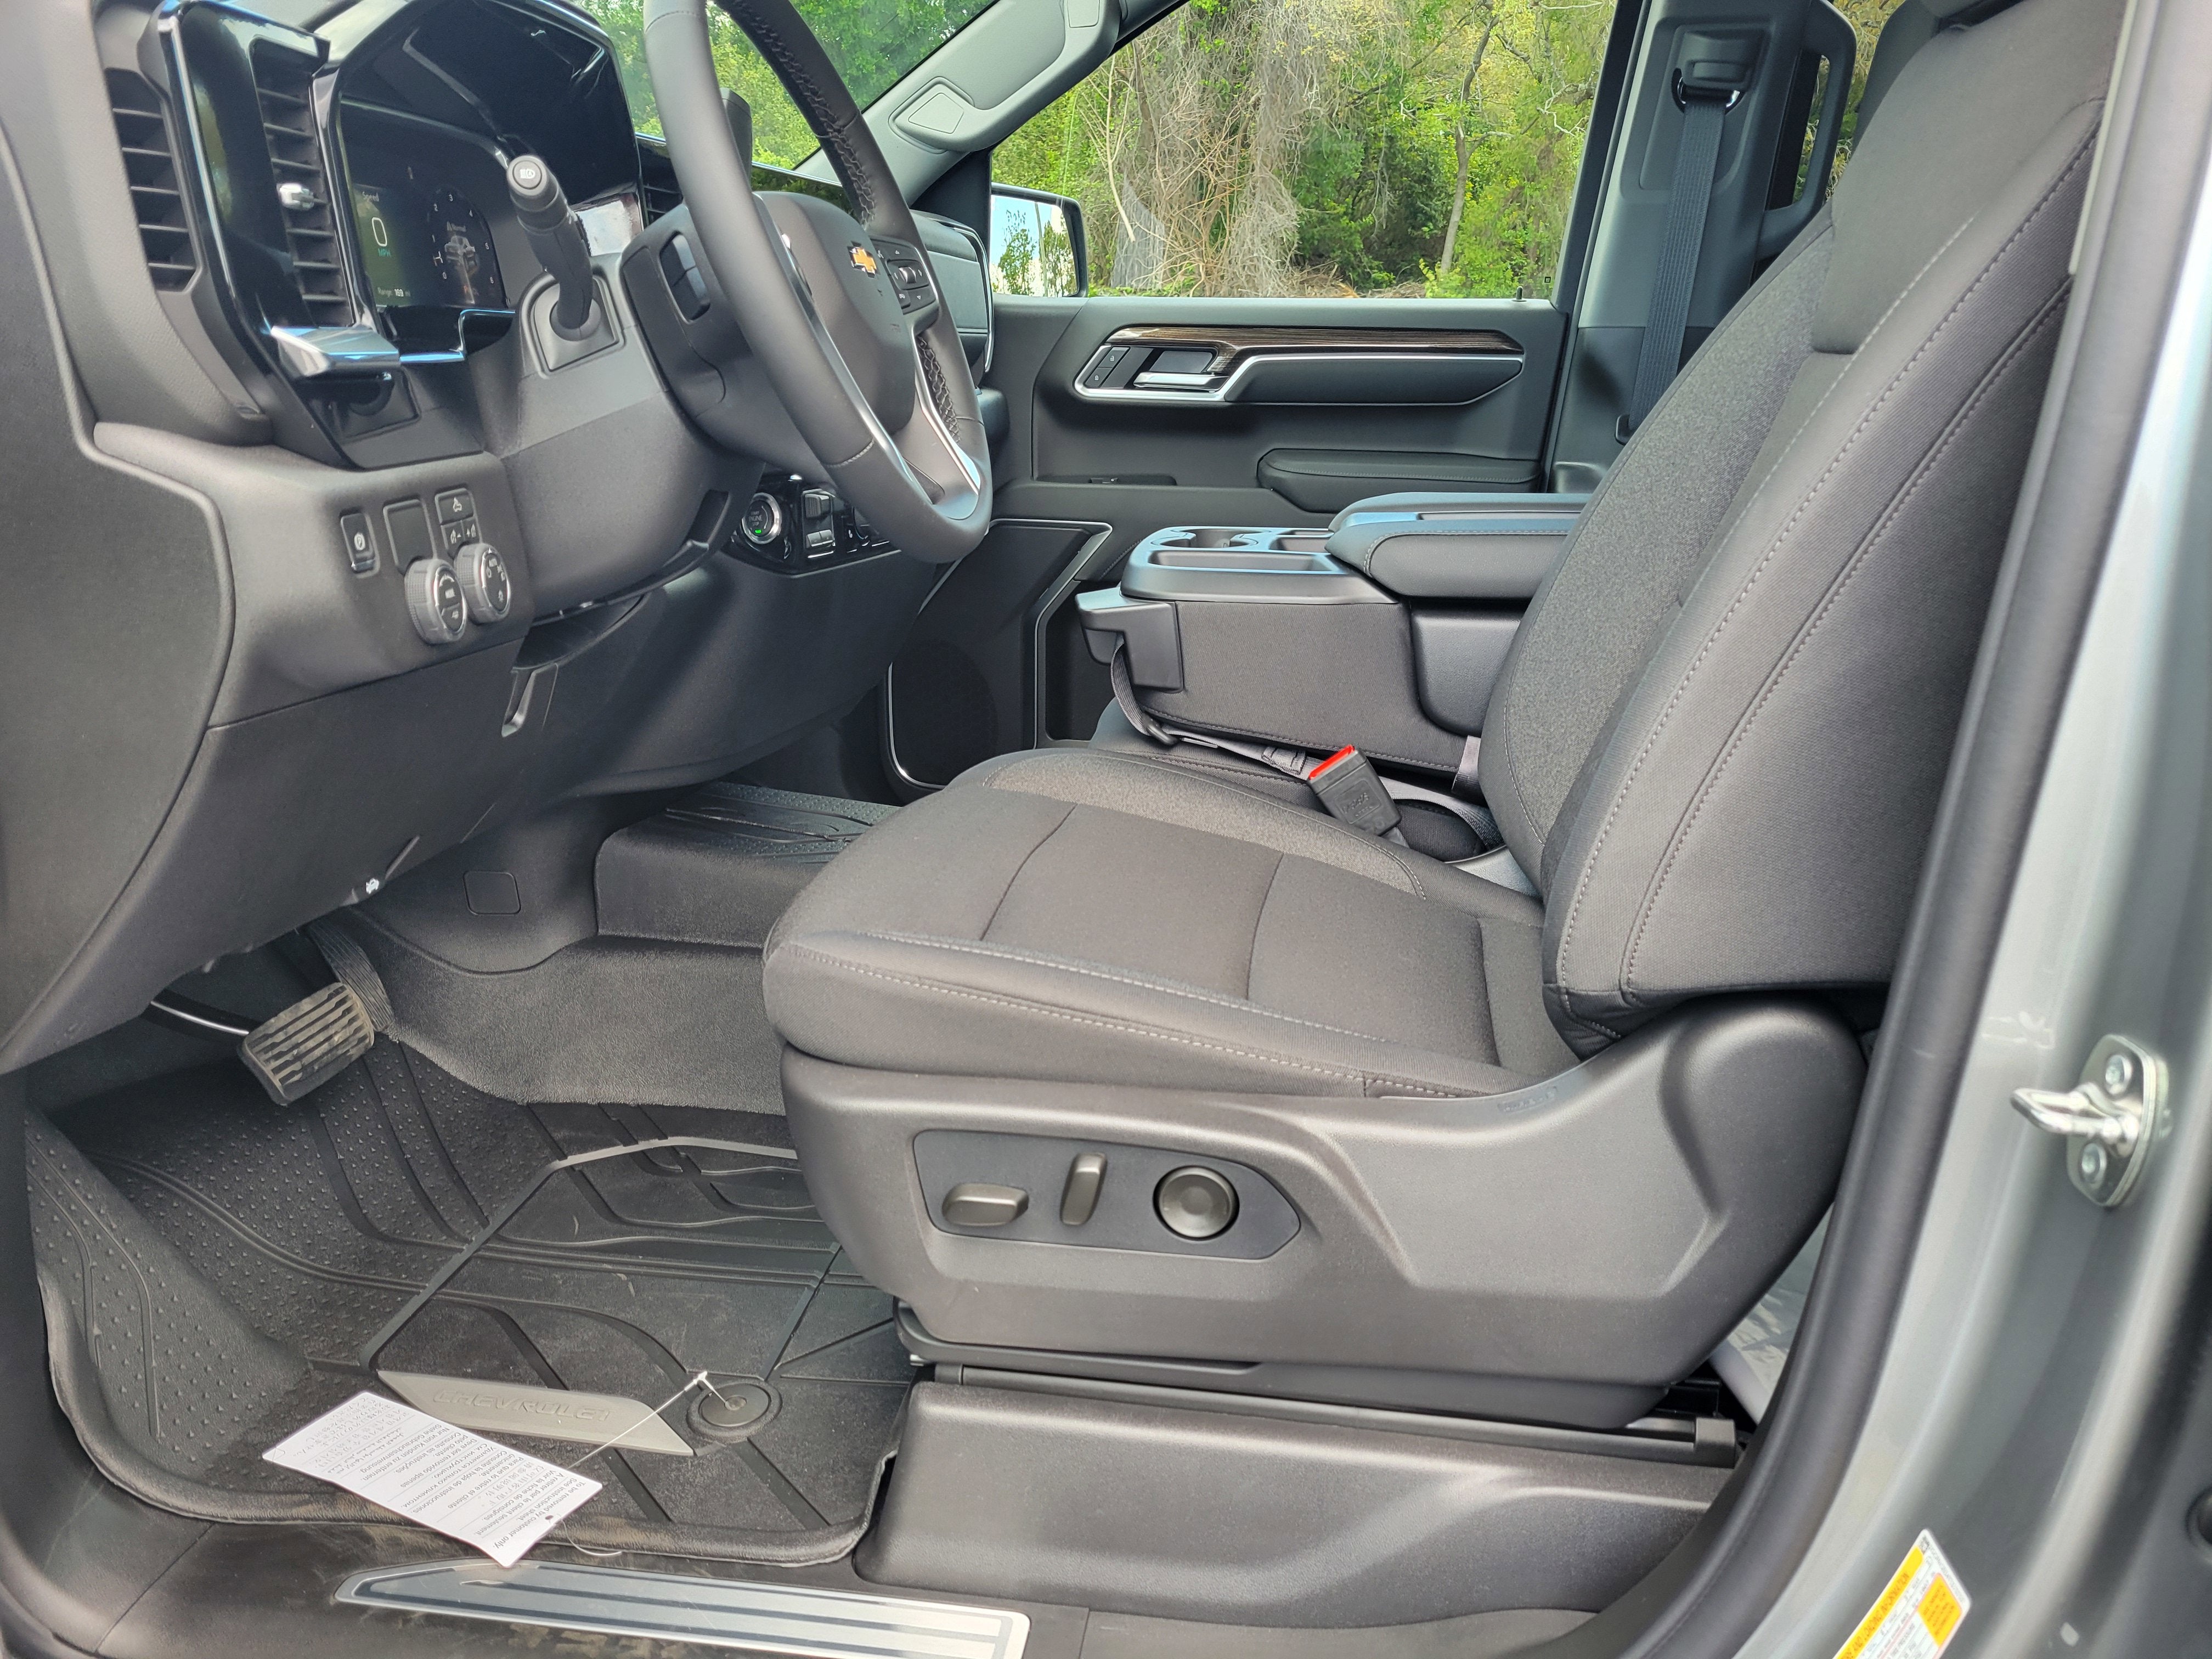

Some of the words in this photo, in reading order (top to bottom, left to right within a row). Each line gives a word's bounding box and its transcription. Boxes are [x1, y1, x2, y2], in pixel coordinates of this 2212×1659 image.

[371, 217, 388, 247] 0
[433, 1389, 612, 1422] CHEVROLET
[399, 1441, 426, 1458] Kunden
[422, 1454, 452, 1474] removido
[506, 1456, 524, 1466] Para
[496, 1465, 510, 1475] que
[473, 1477, 492, 1491] retire
[539, 1476, 558, 1491] retirer
[562, 1477, 577, 1487] See
[447, 1493, 469, 1509] cliente
[529, 1488, 541, 1499] par
[533, 1486, 566, 1509] instruction
[505, 1502, 524, 1515] client
[543, 1492, 569, 1512] removed
[534, 1510, 546, 1518] by
[507, 1516, 537, 1537] customer
